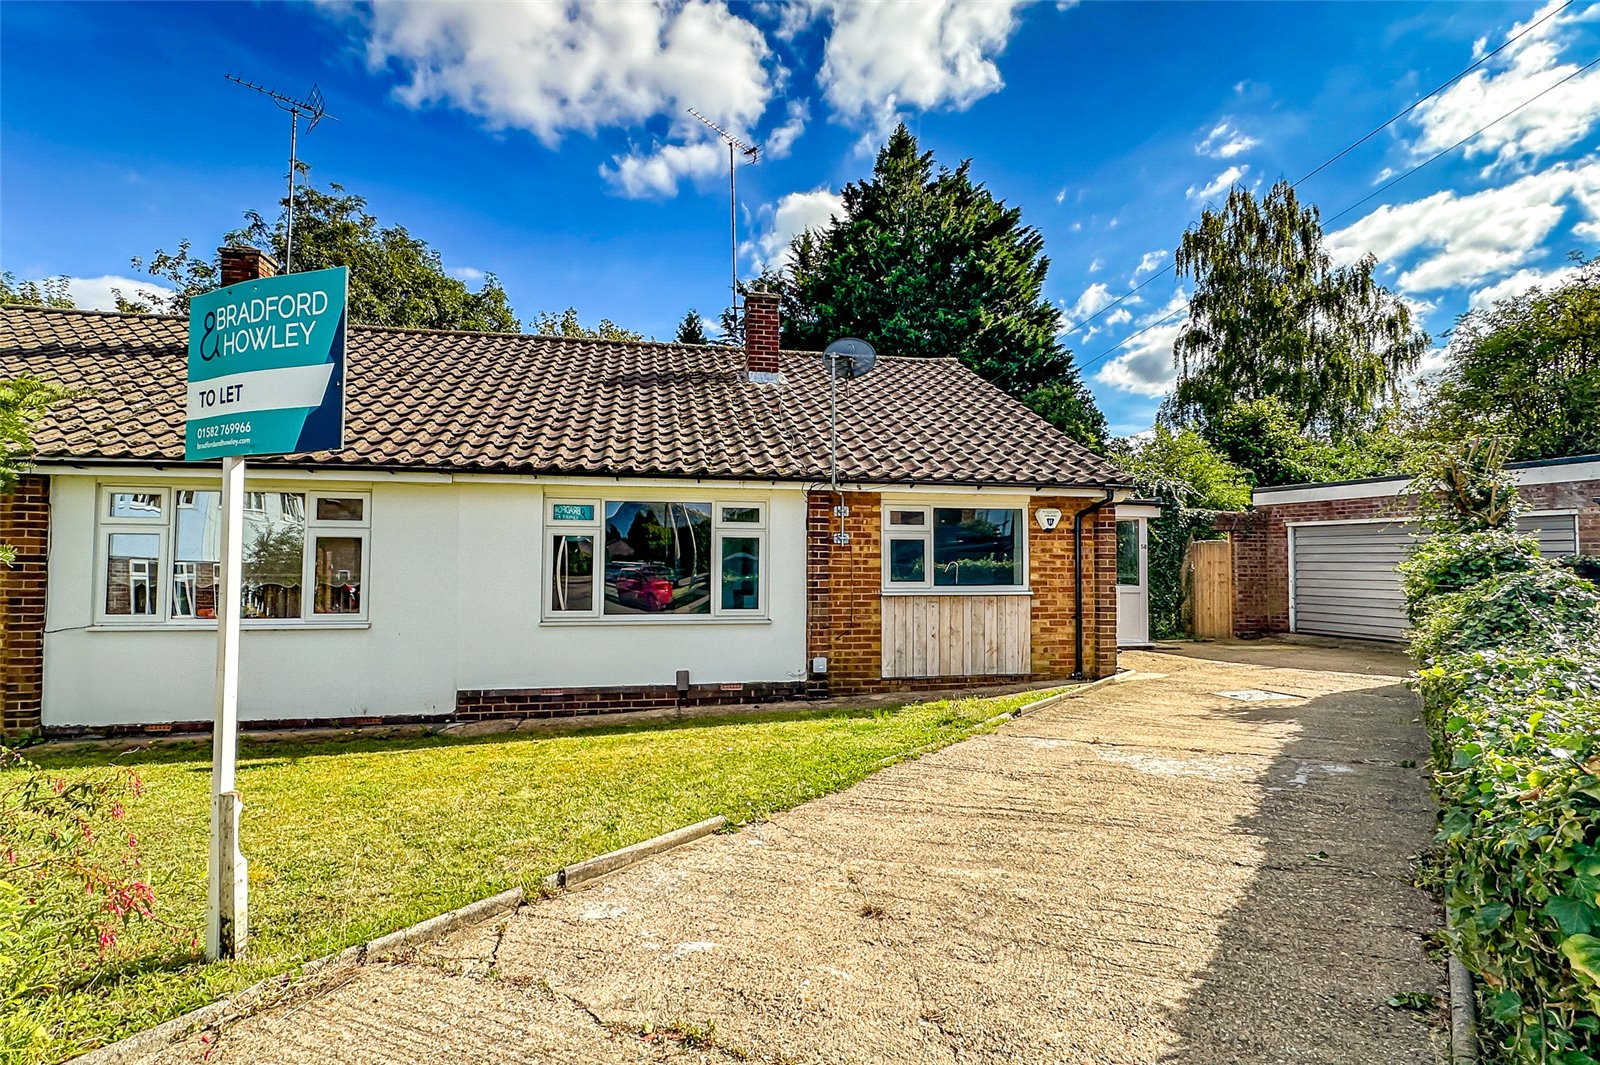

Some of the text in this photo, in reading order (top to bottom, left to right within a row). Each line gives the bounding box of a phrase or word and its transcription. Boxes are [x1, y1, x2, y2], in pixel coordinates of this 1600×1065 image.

[216, 291, 328, 330] BRADFORD
[200, 311, 317, 362] & HOWLEY
[199, 384, 243, 408] TO LET
[197, 421, 251, 439] 01582 769966
